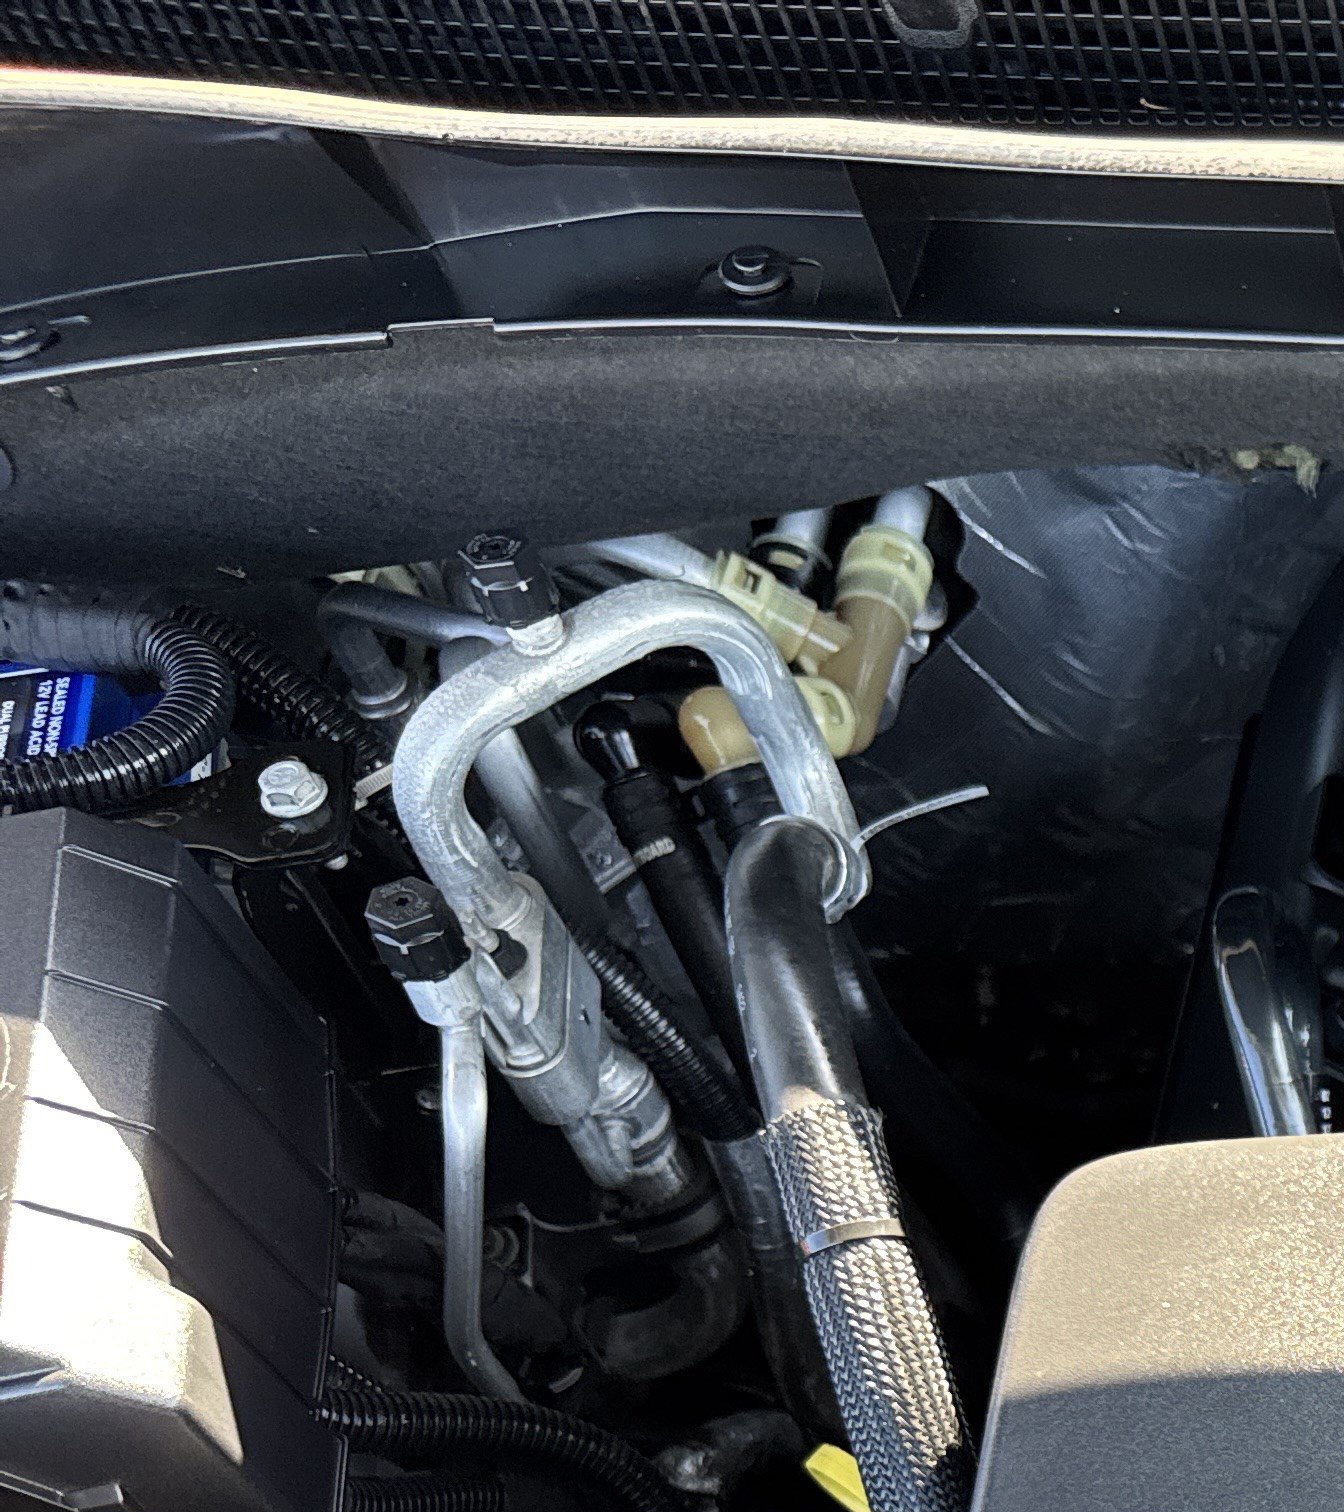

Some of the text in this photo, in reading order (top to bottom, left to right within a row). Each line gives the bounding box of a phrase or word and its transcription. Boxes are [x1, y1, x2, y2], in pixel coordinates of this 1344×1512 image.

[26, 680, 53, 756] 12V LEAD ACID
[51, 677, 70, 715] SEALED
